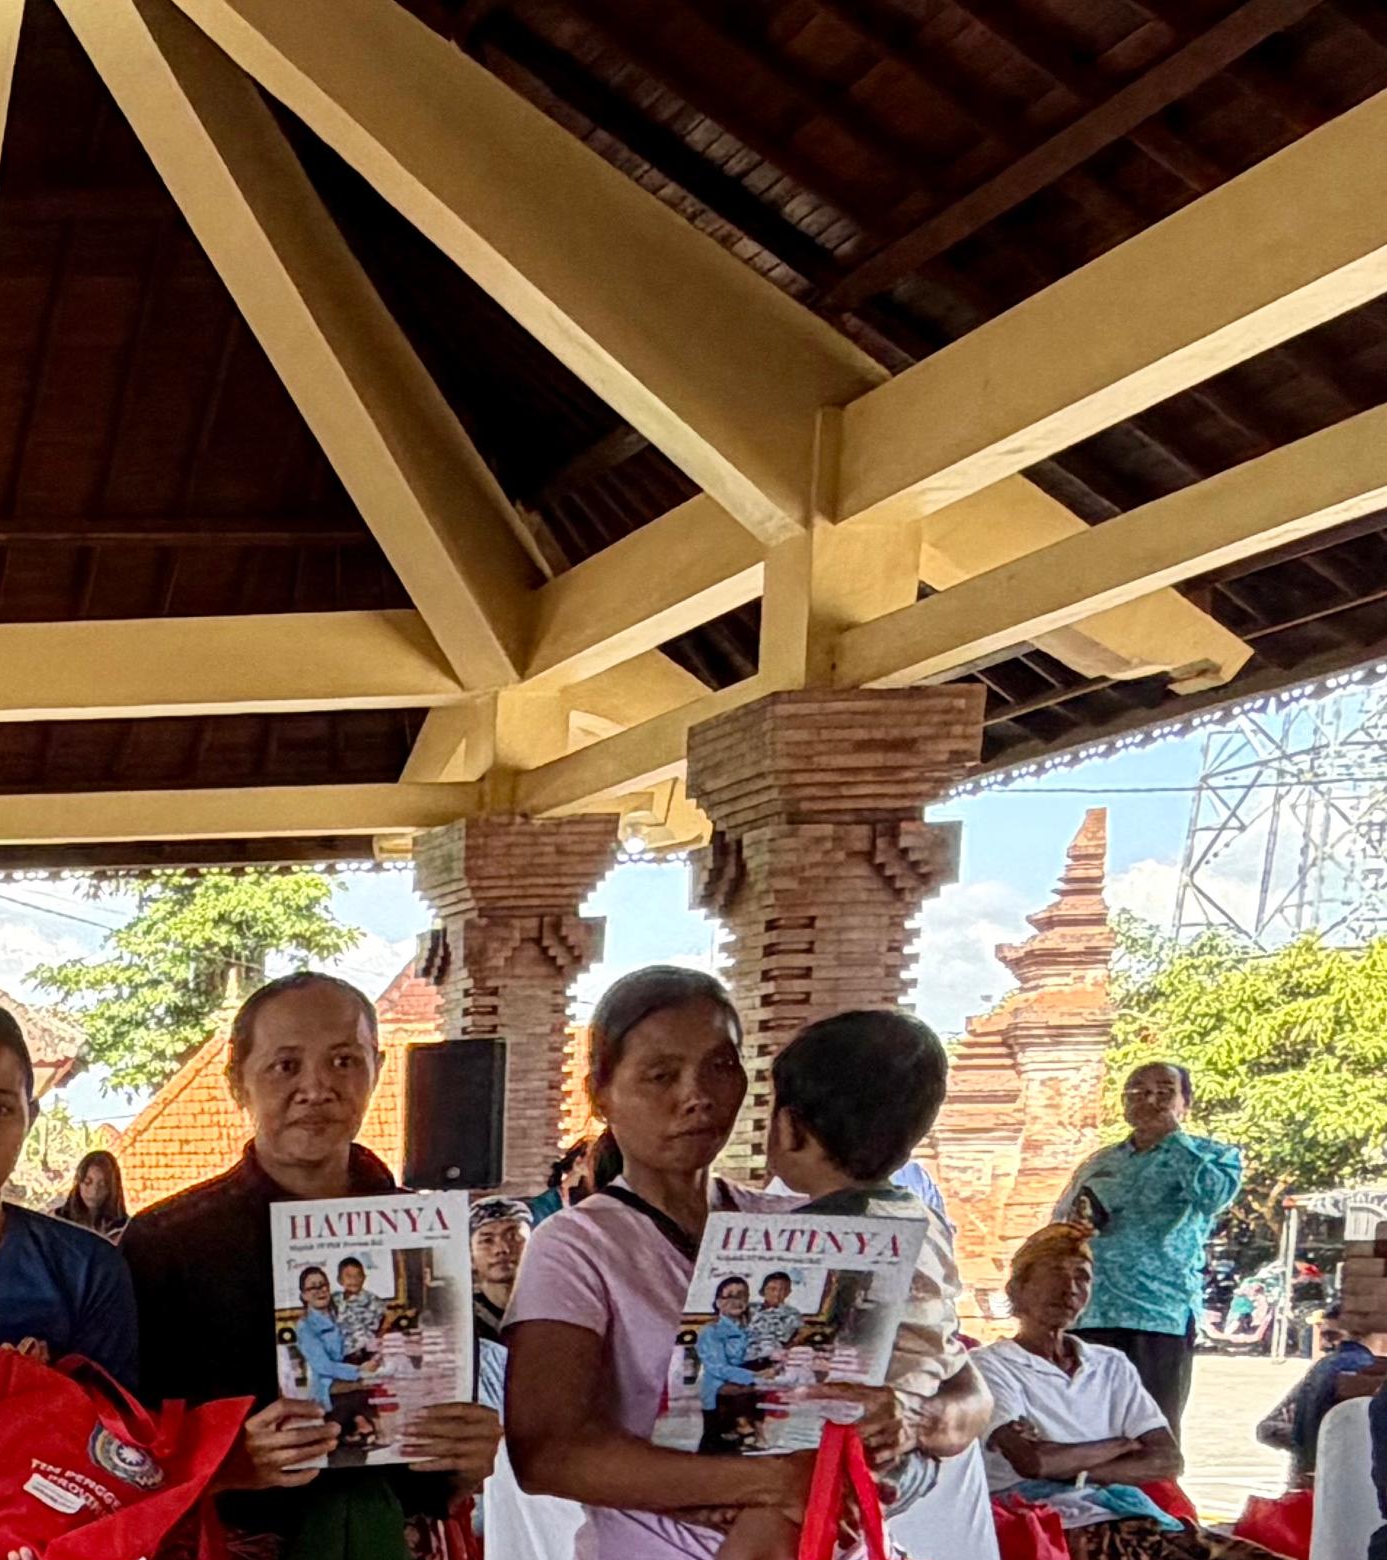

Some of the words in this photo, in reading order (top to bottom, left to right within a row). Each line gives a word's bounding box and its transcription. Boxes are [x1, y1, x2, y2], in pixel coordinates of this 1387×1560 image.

[289, 1207, 449, 1240] HATINYA
[722, 1227, 900, 1257] HATINYA
[30, 1458, 62, 1475] TIM
